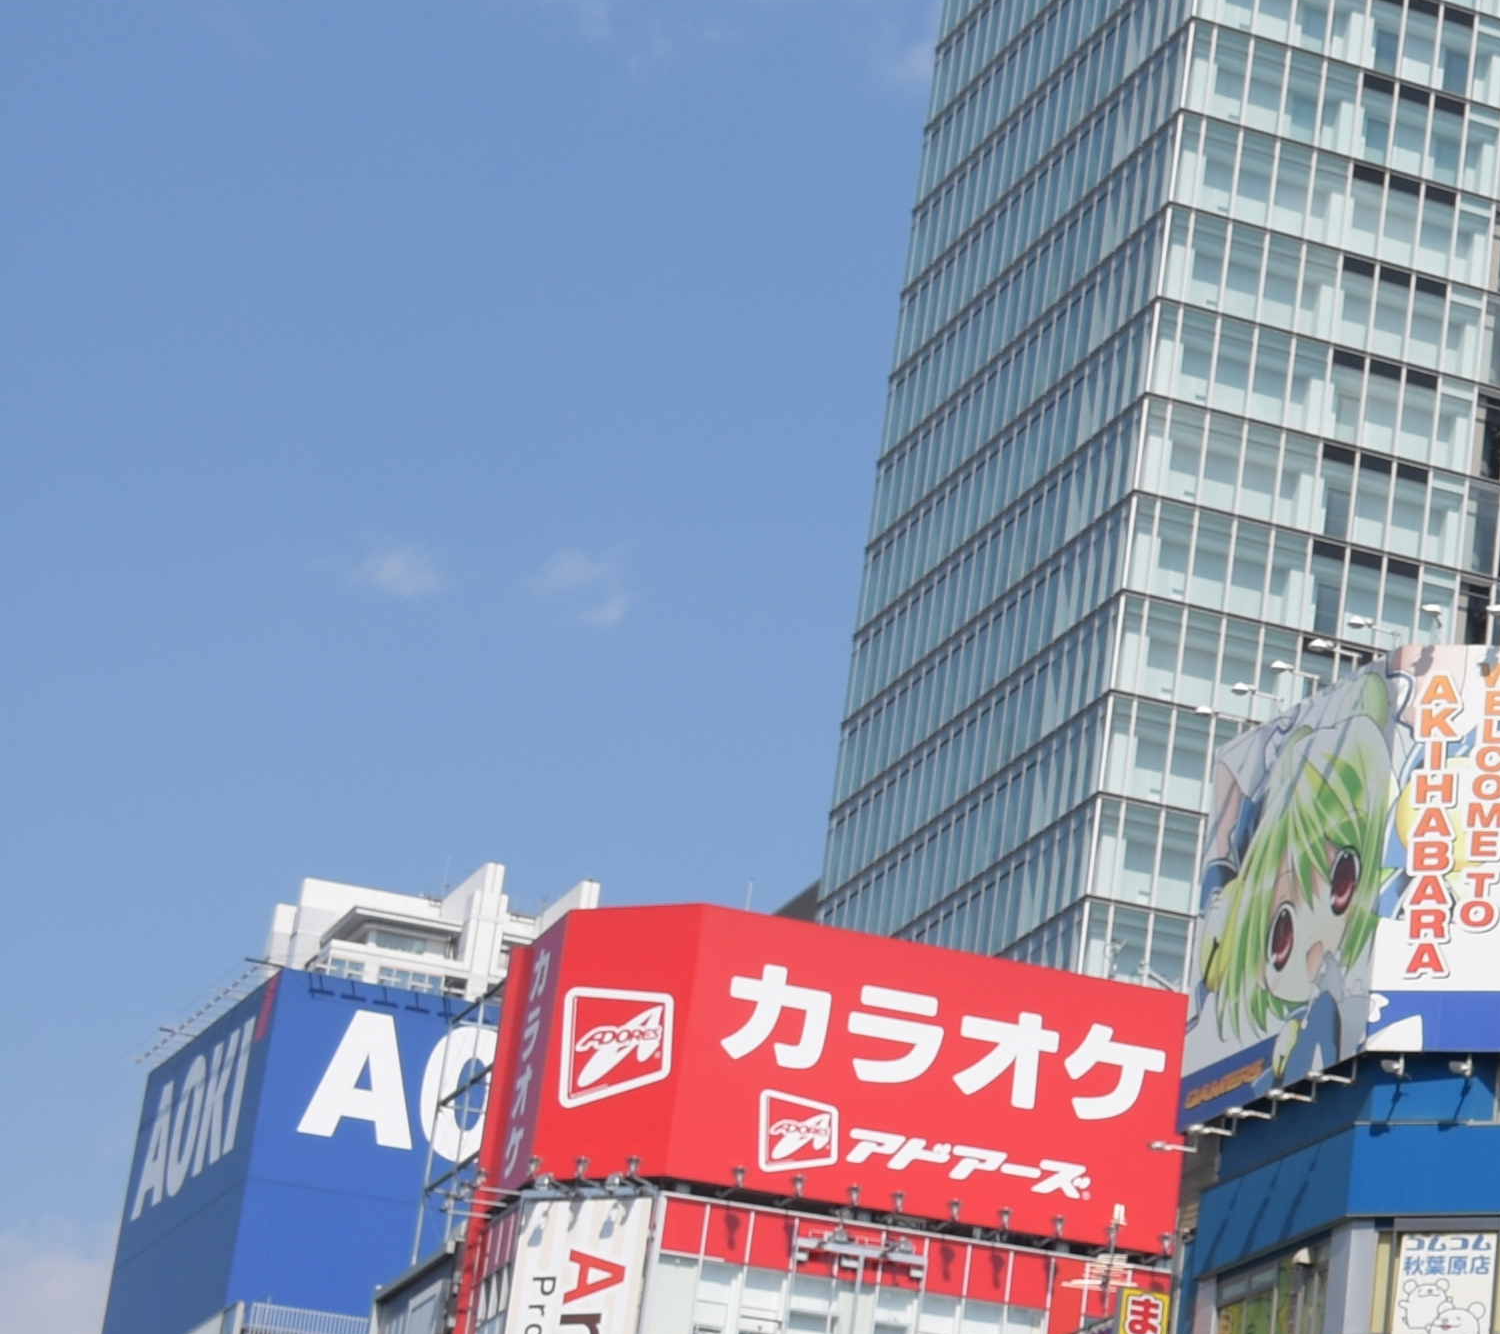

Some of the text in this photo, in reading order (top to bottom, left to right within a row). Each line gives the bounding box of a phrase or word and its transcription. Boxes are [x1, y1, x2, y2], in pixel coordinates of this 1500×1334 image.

[1403, 670, 1459, 979] AKIHABARA
[1464, 870, 1497, 933] TO
[129, 1013, 260, 1222] AOKI
[503, 946, 552, 1181] カラオケ
[718, 962, 1168, 1123] カラオケ
[844, 1126, 1091, 1202] アドアーズ
[1402, 1255, 1490, 1277] 秋葉原店
